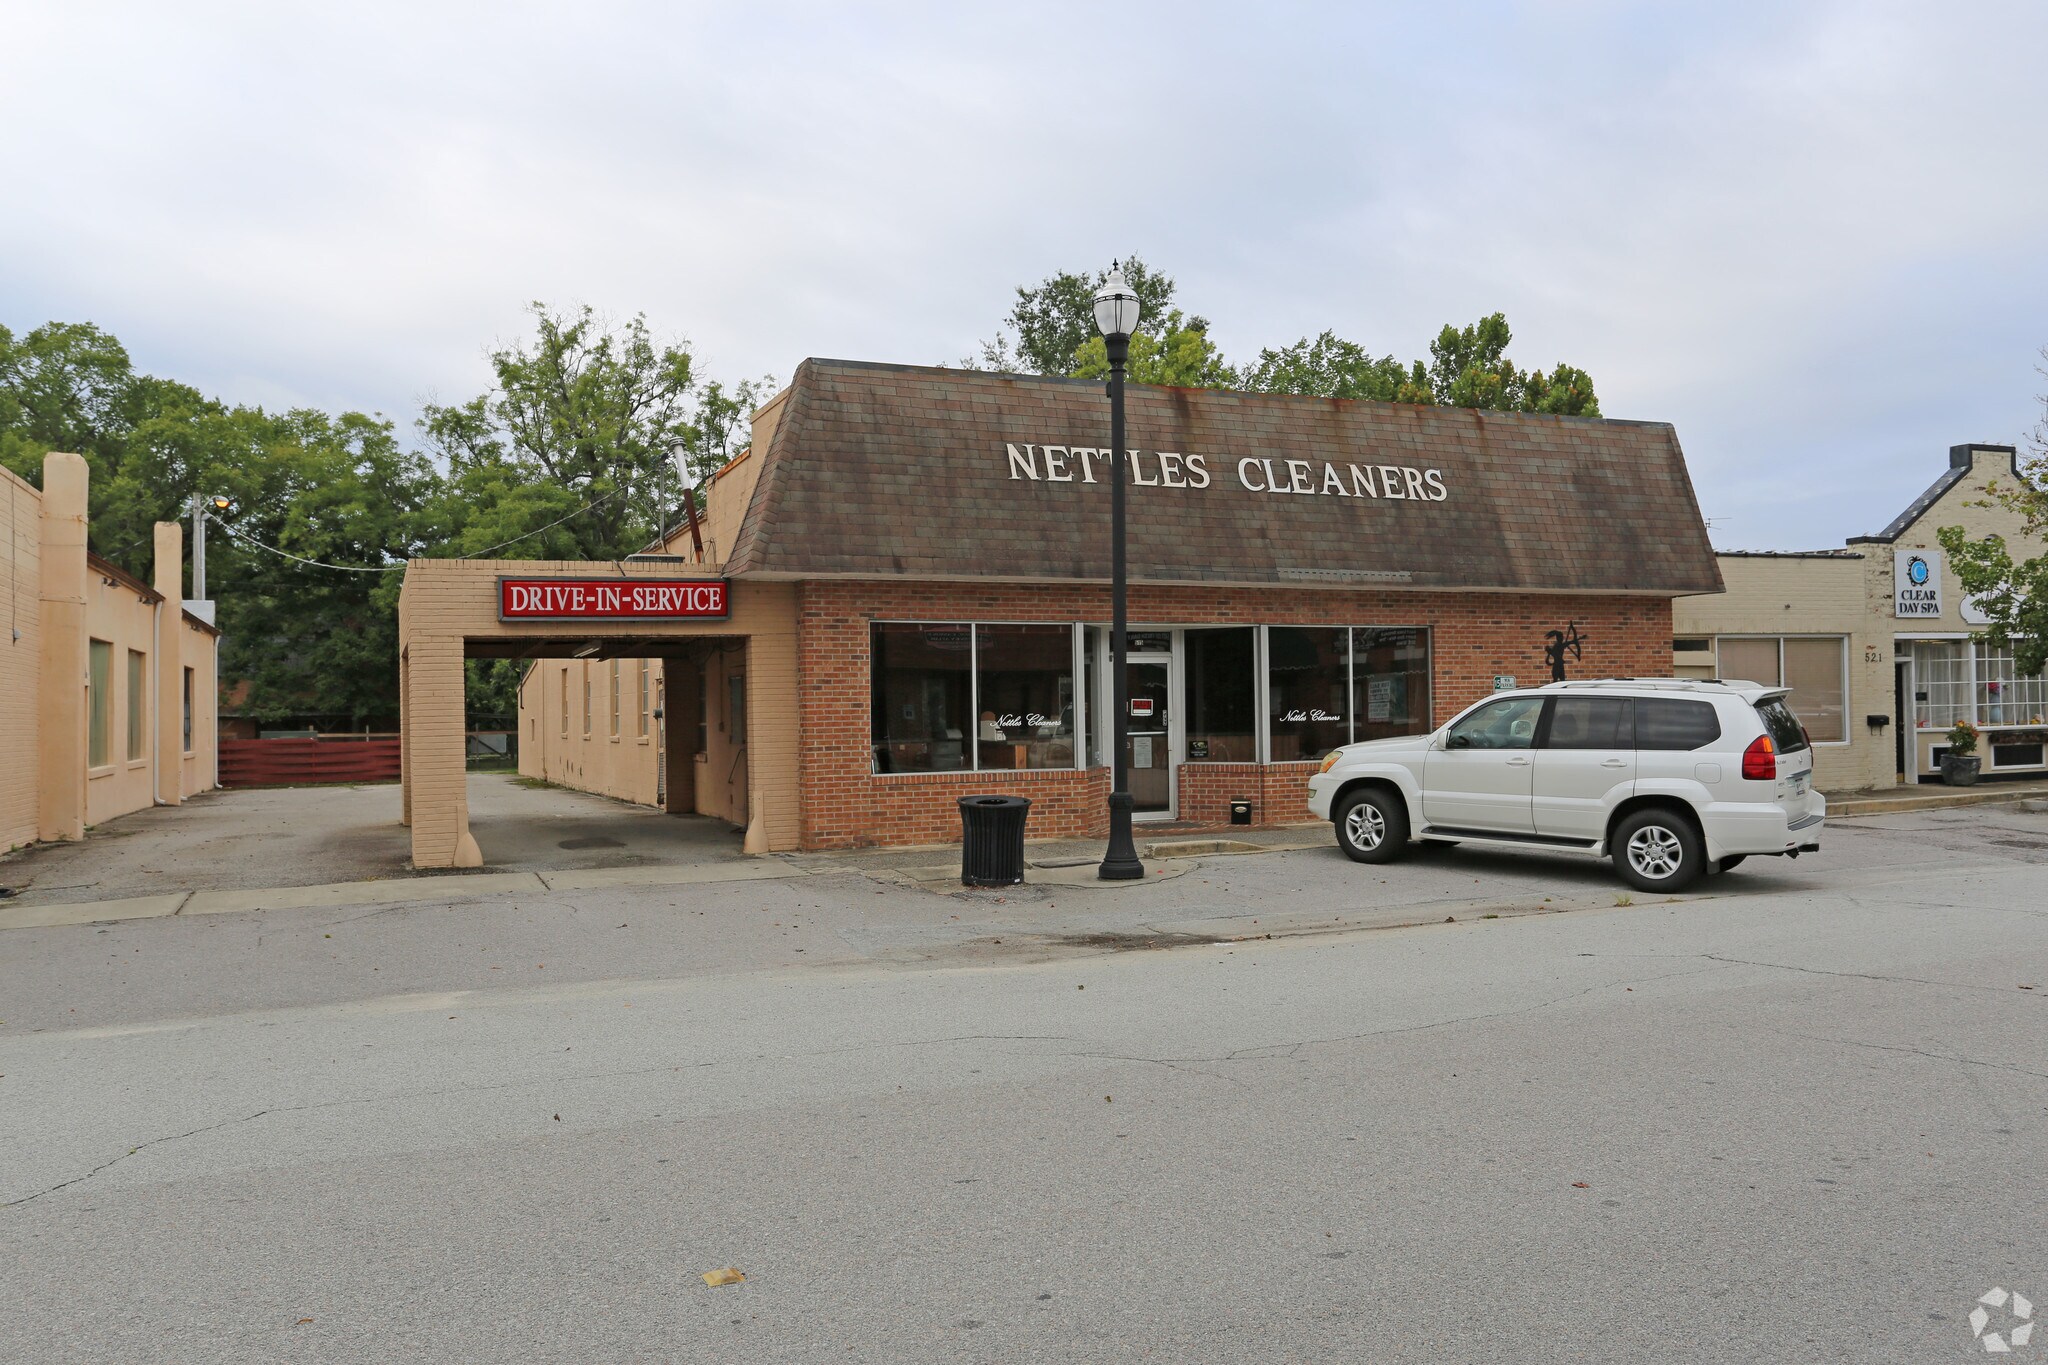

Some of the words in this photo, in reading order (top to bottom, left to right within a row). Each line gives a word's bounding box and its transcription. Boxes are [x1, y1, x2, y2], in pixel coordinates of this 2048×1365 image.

[1237, 457, 1448, 502] CLEANERS
[510, 586, 722, 611] DRIVE-IN-SERVICE
[1901, 590, 1937, 601] CLEAR
[1899, 602, 1920, 614] DAY
[1920, 602, 1940, 614] SPA
[1865, 652, 1882, 663] 521
[989, 713, 1022, 727] Nettles
[1025, 713, 1062, 727] Cleaners
[1279, 709, 1307, 722] Nettles
[1309, 708, 1341, 722] Cleaners
